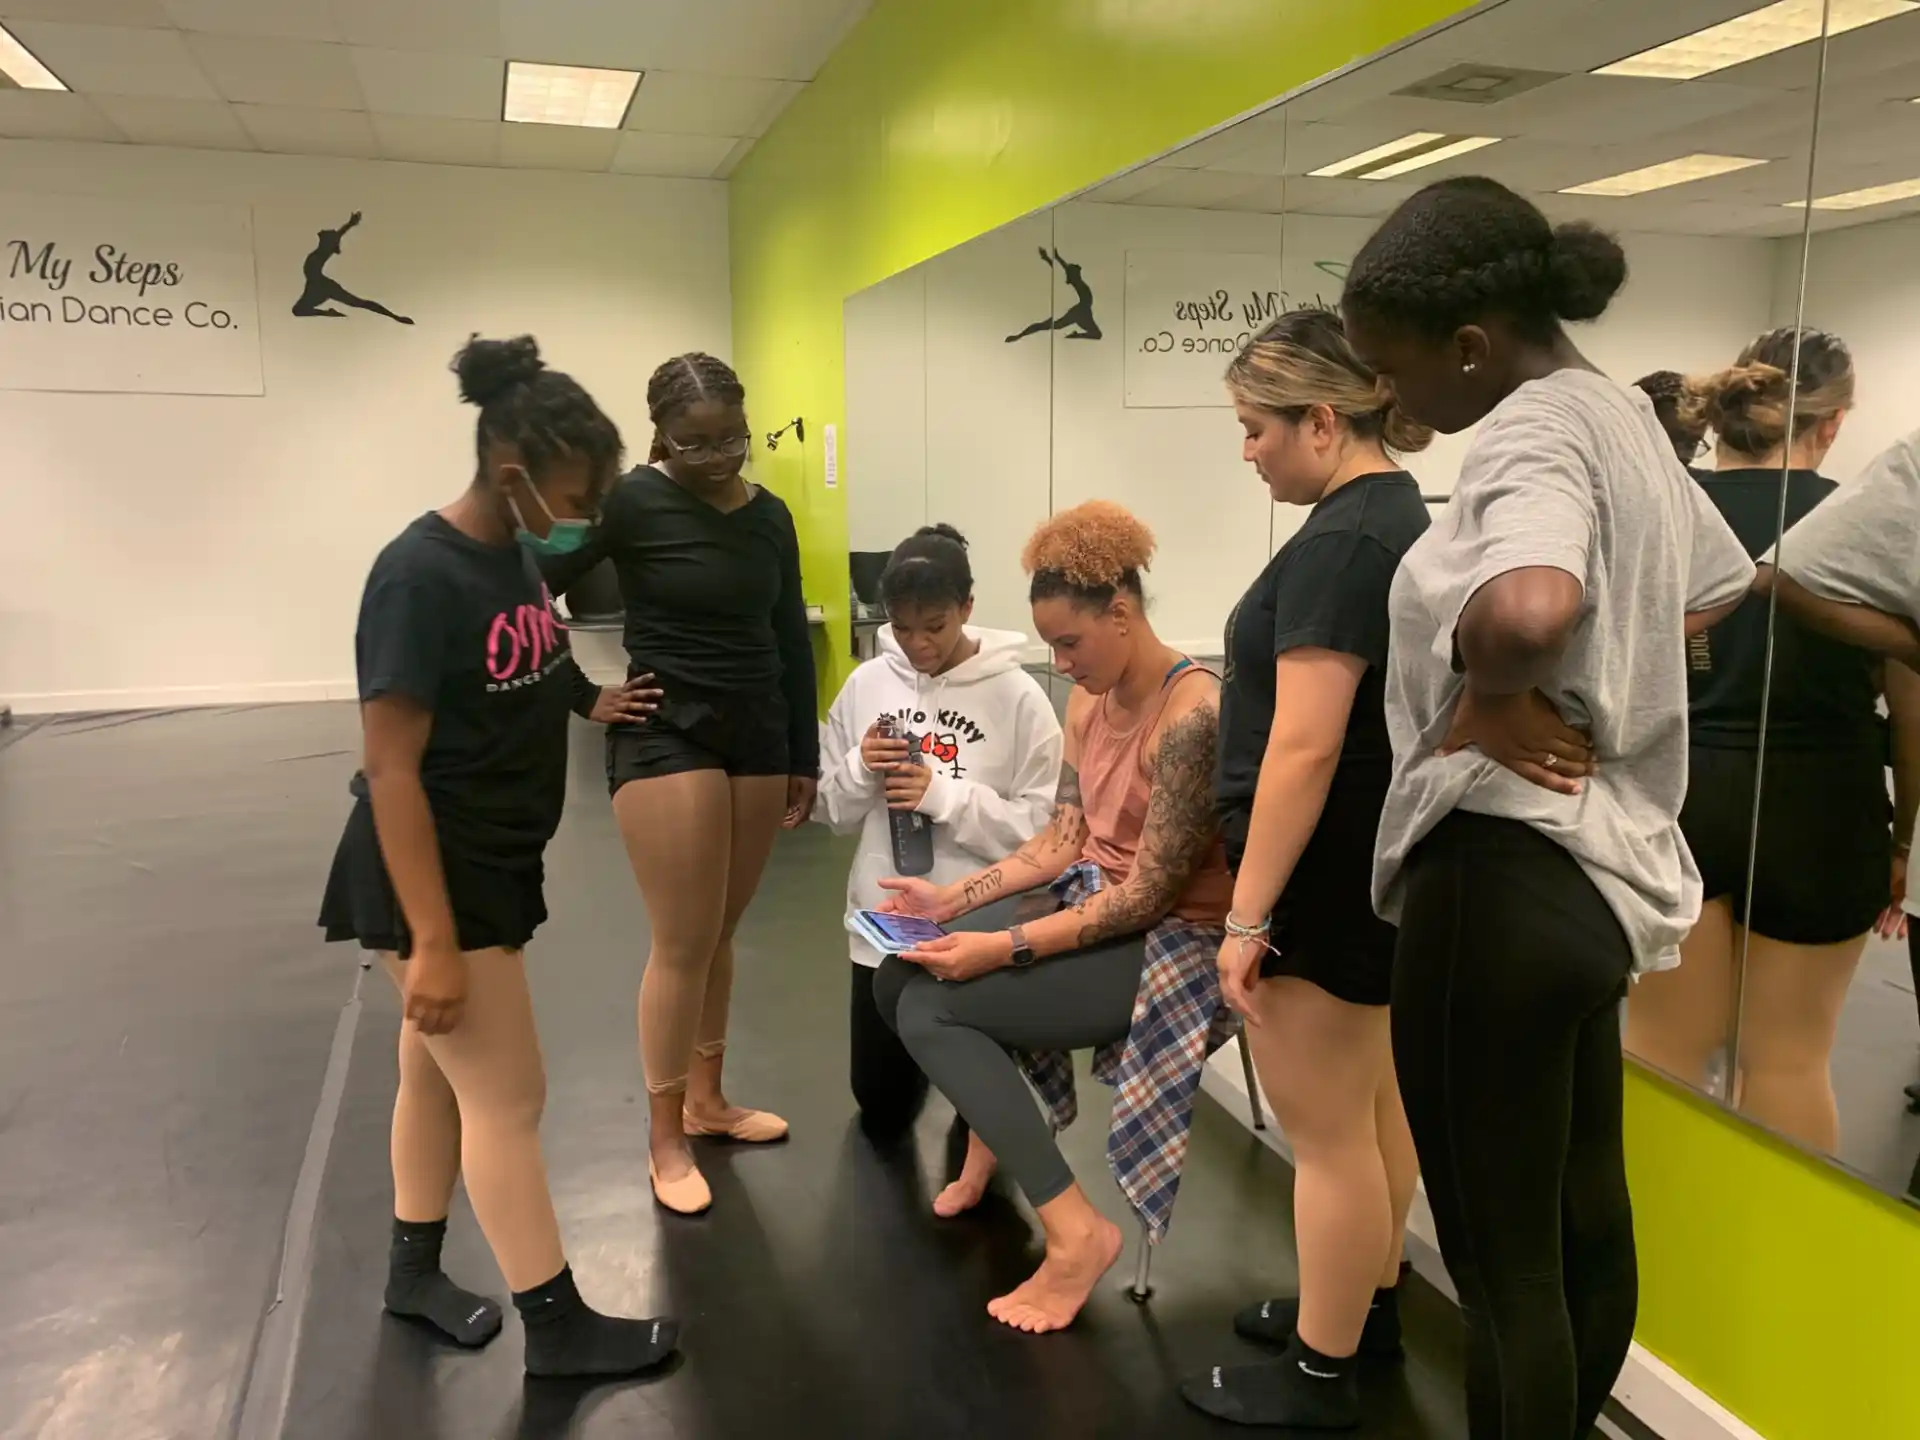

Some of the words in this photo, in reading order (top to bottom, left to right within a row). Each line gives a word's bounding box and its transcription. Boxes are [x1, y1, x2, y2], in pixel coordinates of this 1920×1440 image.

[7, 240, 72, 290] My
[89, 243, 183, 297] Steps
[62, 296, 173, 327] Dance
[184, 301, 239, 329] Co.
[934, 708, 985, 744] Kitty
